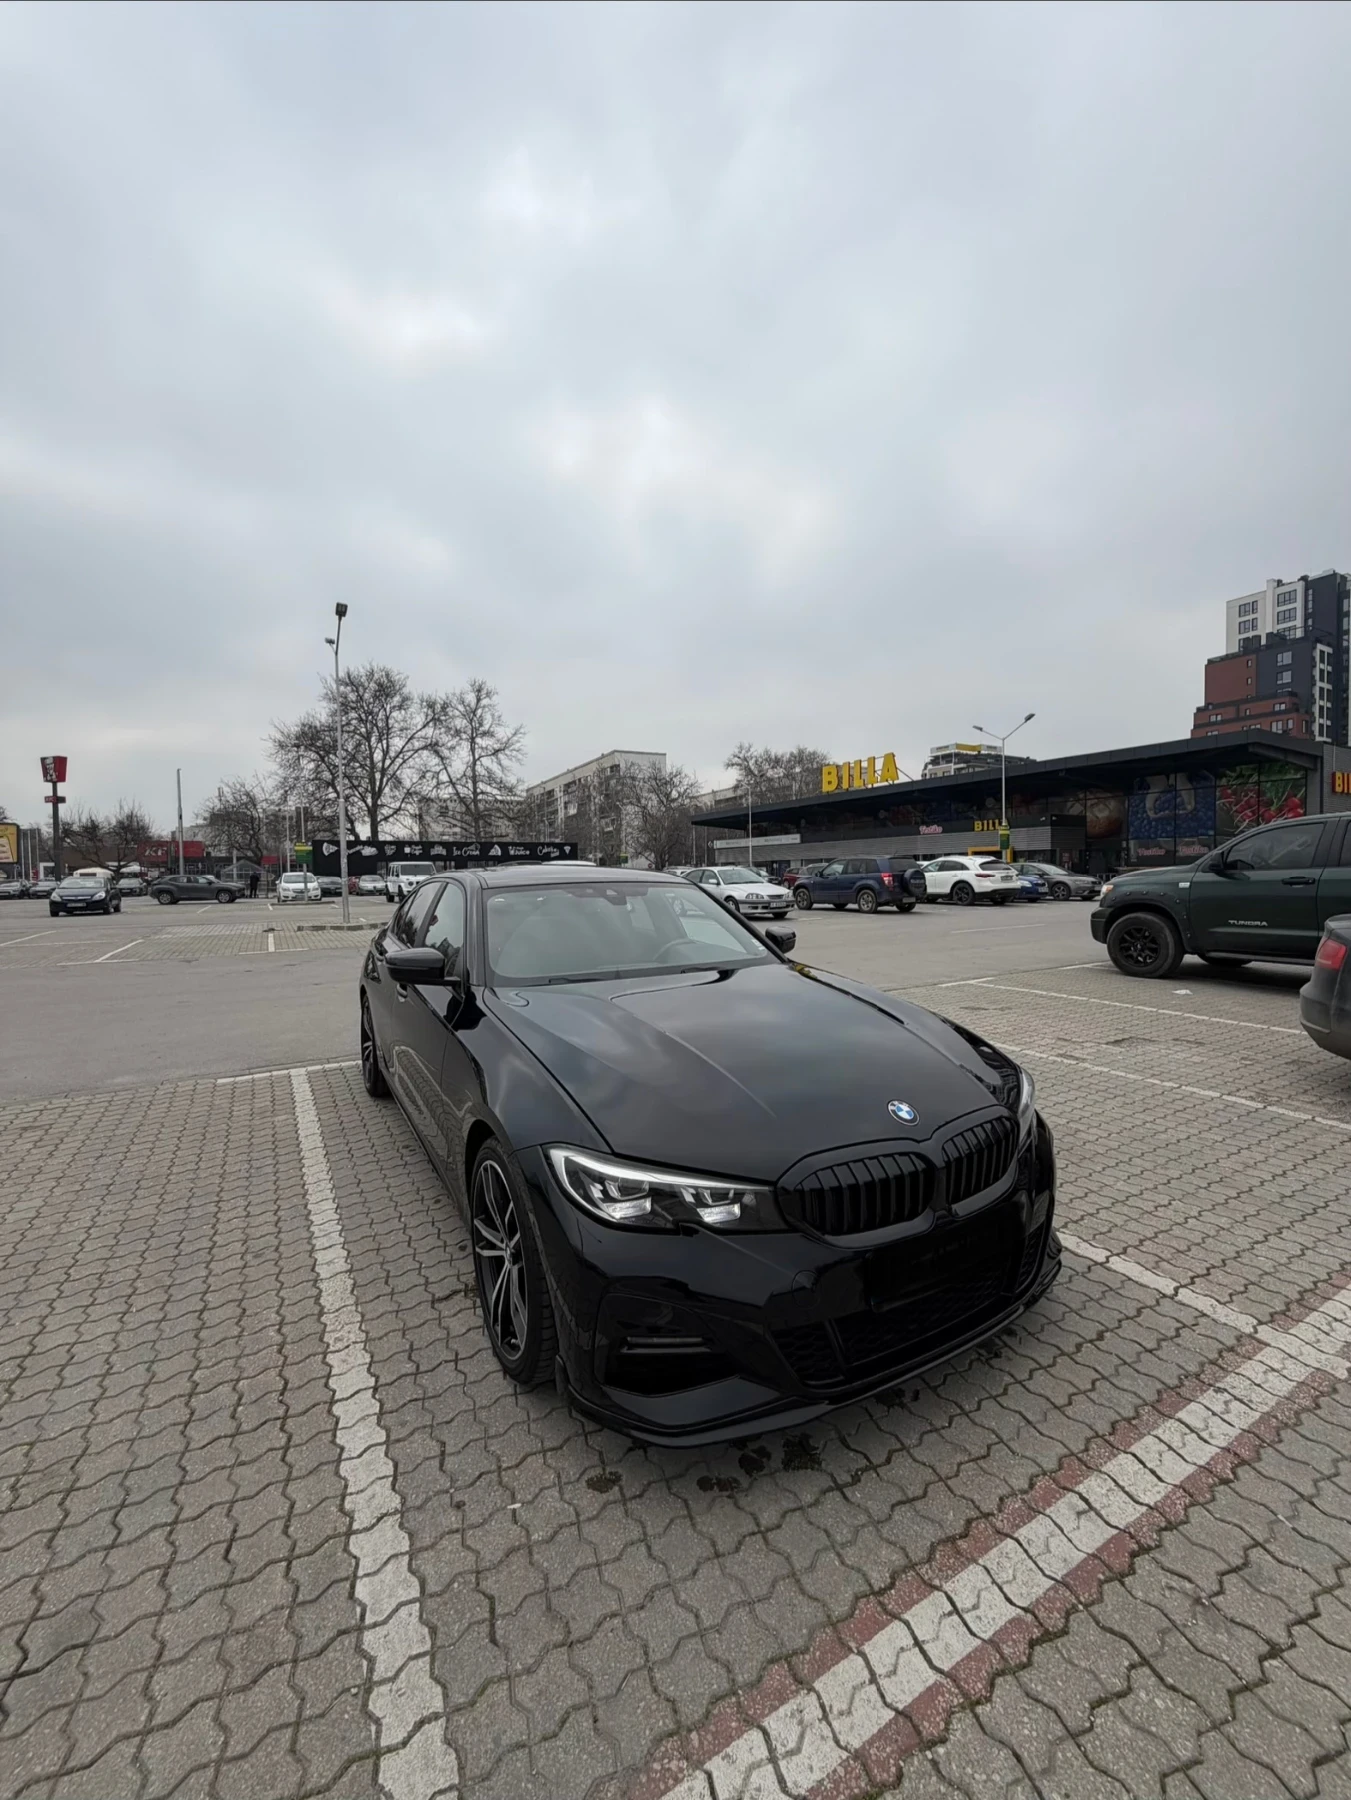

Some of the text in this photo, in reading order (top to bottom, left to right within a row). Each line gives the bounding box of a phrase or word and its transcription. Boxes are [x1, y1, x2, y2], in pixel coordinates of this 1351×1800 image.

[822, 752, 899, 792] BILLA
[1335, 771, 1351, 793] BI
[974, 819, 1007, 832] BILL
[1228, 919, 1268, 927] TUNDRA
